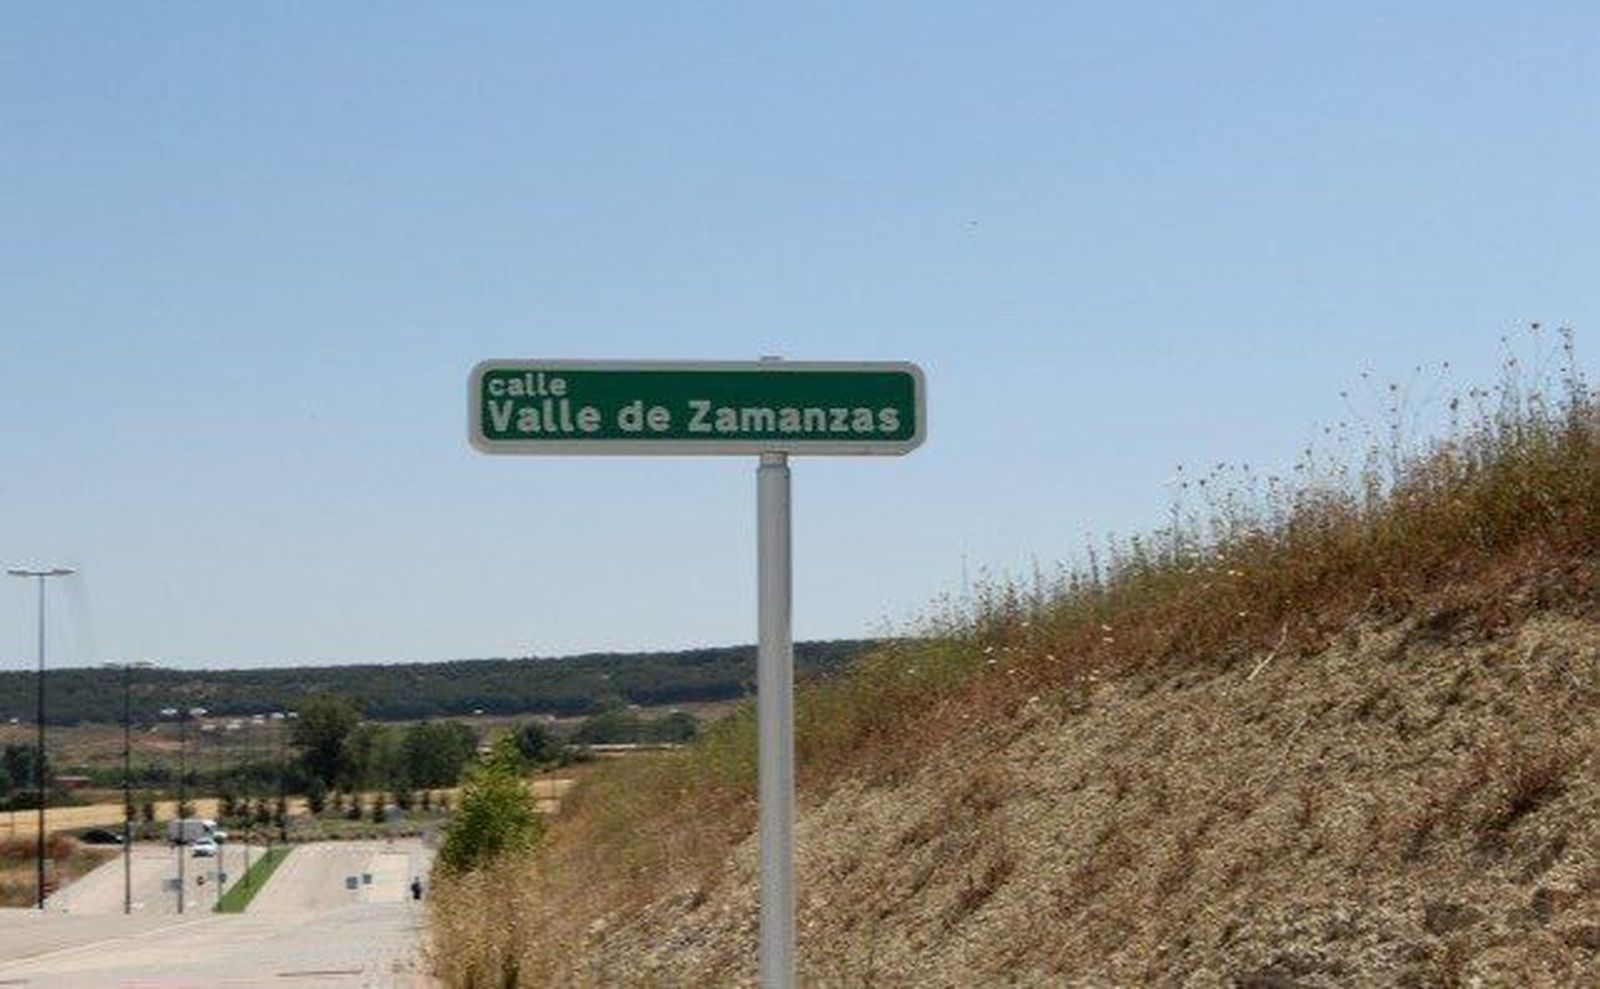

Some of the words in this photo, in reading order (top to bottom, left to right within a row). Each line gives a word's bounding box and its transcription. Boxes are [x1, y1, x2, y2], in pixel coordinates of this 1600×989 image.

[488, 372, 567, 397] calle
[488, 400, 602, 433] Valle
[617, 400, 671, 433] de
[688, 400, 900, 433] Zamanzas
